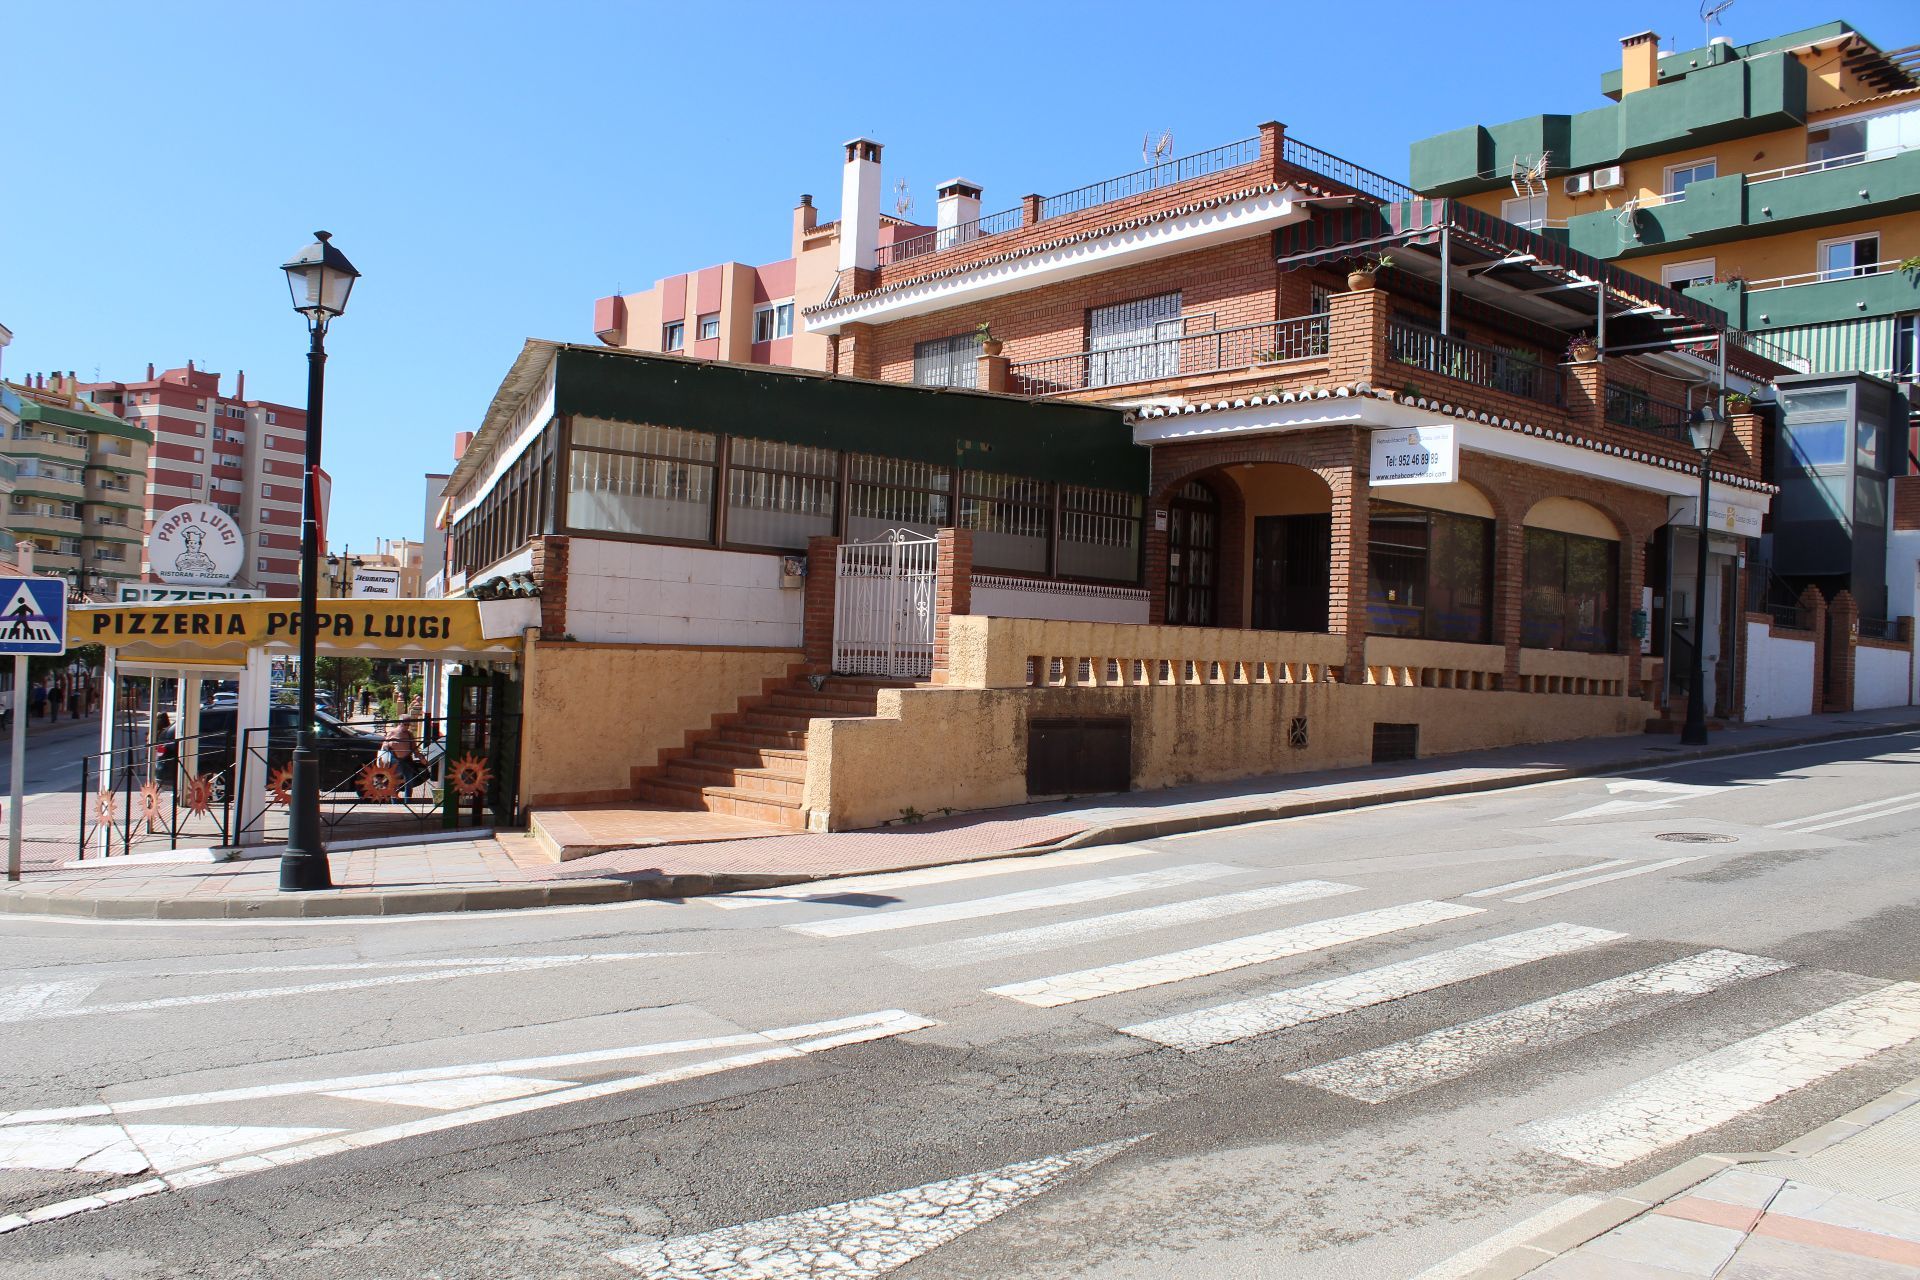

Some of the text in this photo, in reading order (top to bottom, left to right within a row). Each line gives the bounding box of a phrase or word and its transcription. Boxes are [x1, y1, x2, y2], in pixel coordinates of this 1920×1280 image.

[1386, 452, 1439, 467] Tel: 952 46 89 89
[158, 511, 236, 545] PAPA LUIGI
[160, 570, 194, 578] RISTORAN
[92, 612, 451, 639] PIZZERIA PAPA LUIGI
